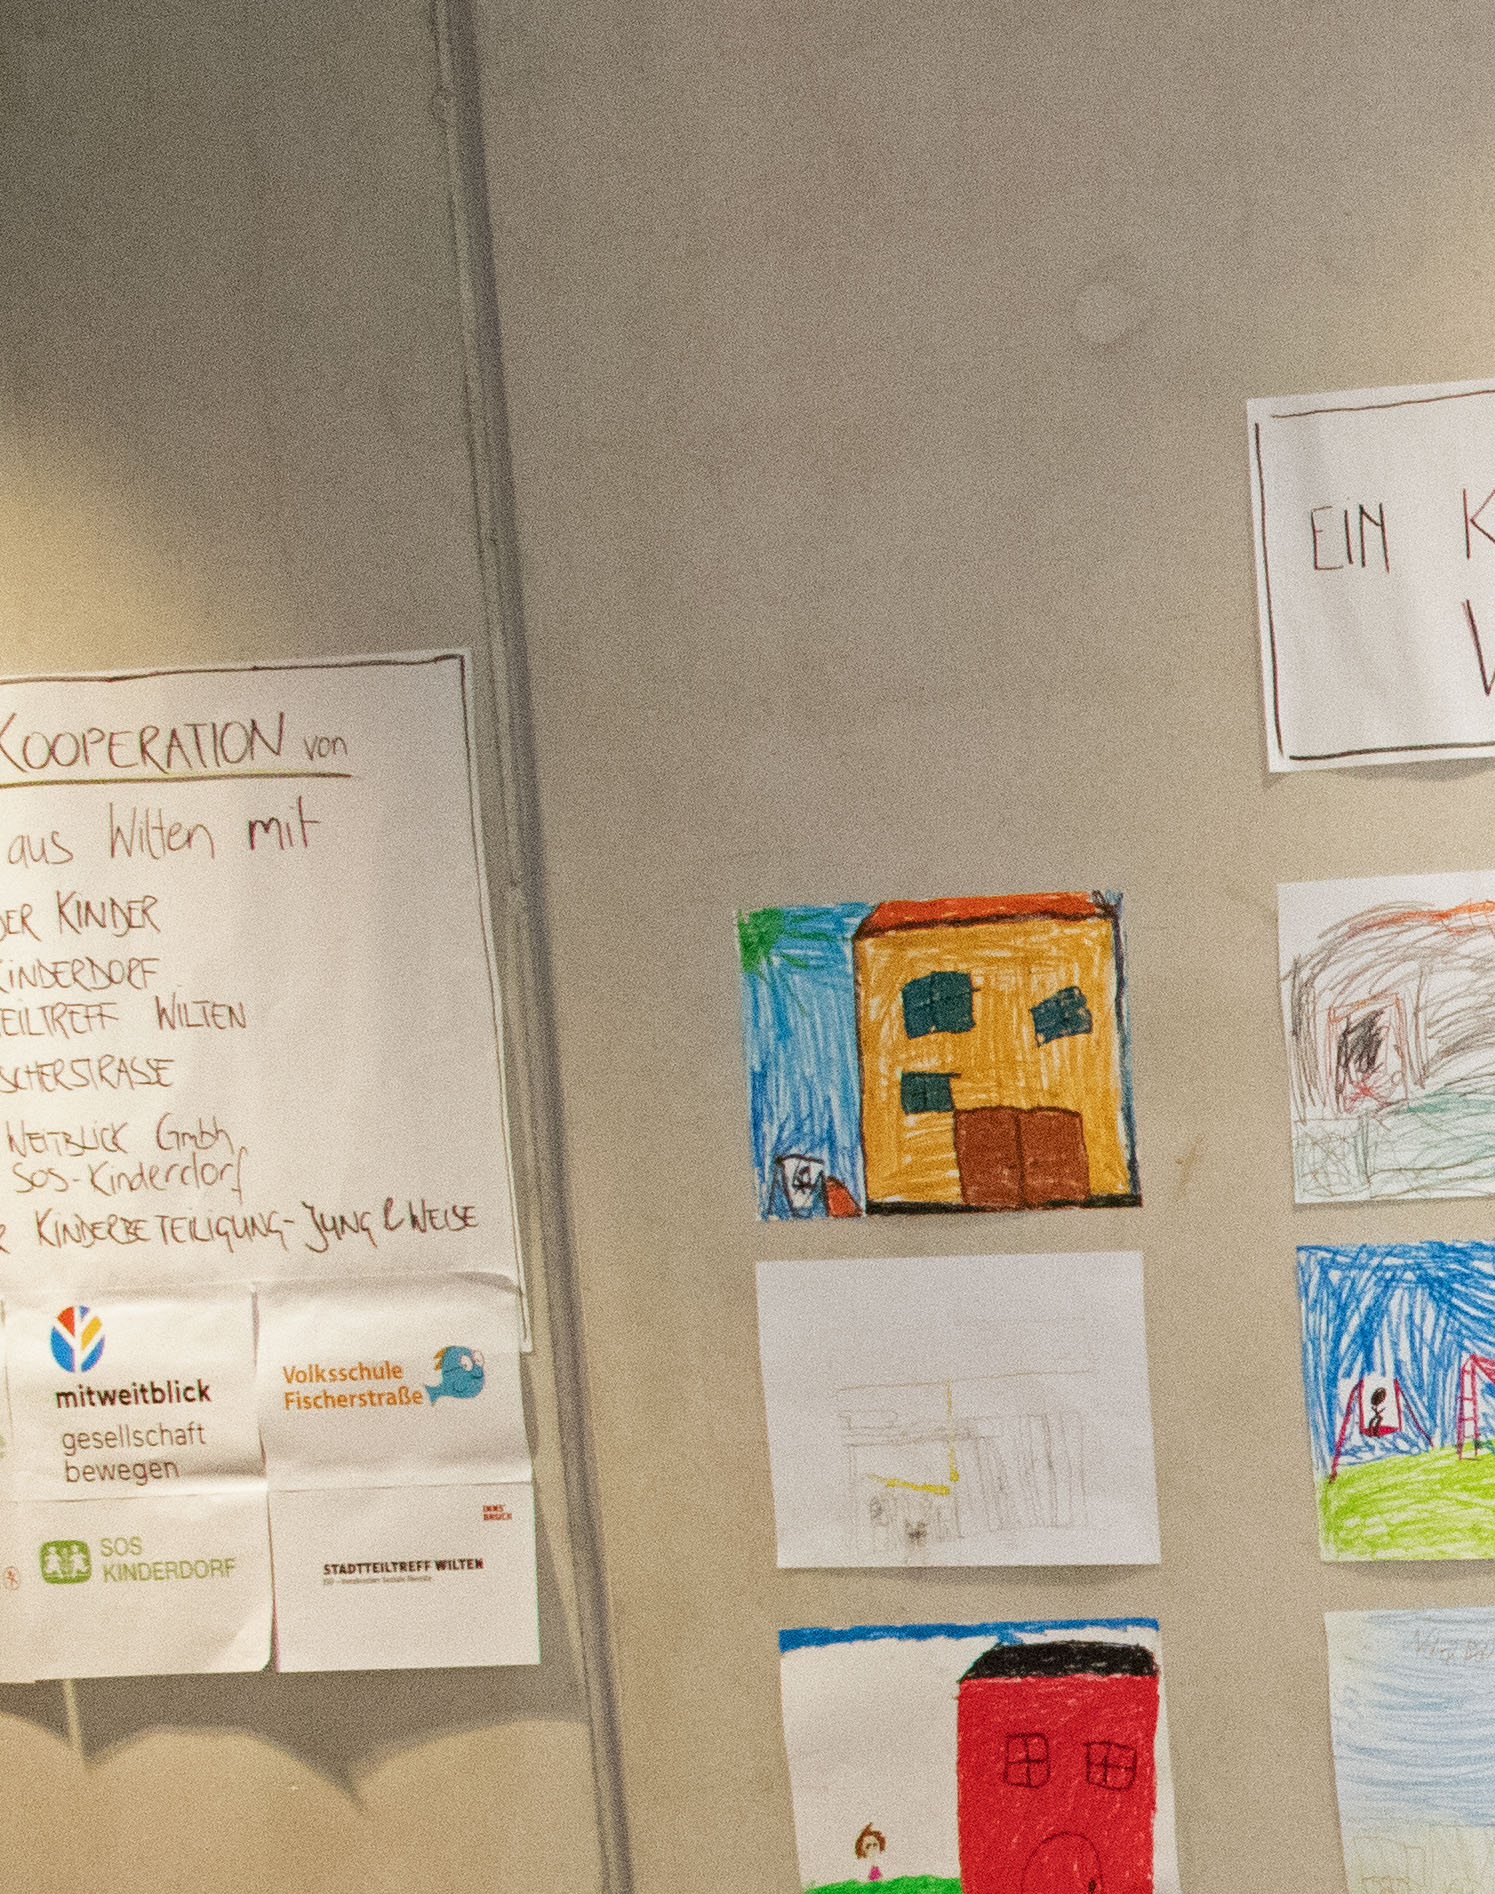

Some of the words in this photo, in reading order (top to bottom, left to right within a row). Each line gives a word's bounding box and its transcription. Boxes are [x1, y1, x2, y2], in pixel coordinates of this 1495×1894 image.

[1311, 502, 1391, 573] EIN
[304, 733, 348, 760] von
[7, 833, 74, 868] aus
[109, 802, 215, 861] Wilten
[248, 796, 321, 850] mit
[56, 889, 161, 938] KINDER
[154, 992, 247, 1031] WILTEN
[5, 1119, 129, 1157] WEITBLICK
[283, 1361, 403, 1385] Volksschule
[55, 1378, 211, 1409] mitweitblick
[285, 1386, 423, 1411] Fischerstraße
[62, 1421, 207, 1456] gesellschaft
[65, 1459, 180, 1487] bewegen
[100, 1536, 142, 1557] SOS
[103, 1557, 237, 1583] KINDERDORF
[322, 1561, 431, 1576] STADTTEILTREFF
[434, 1558, 485, 1573] WILTEN
